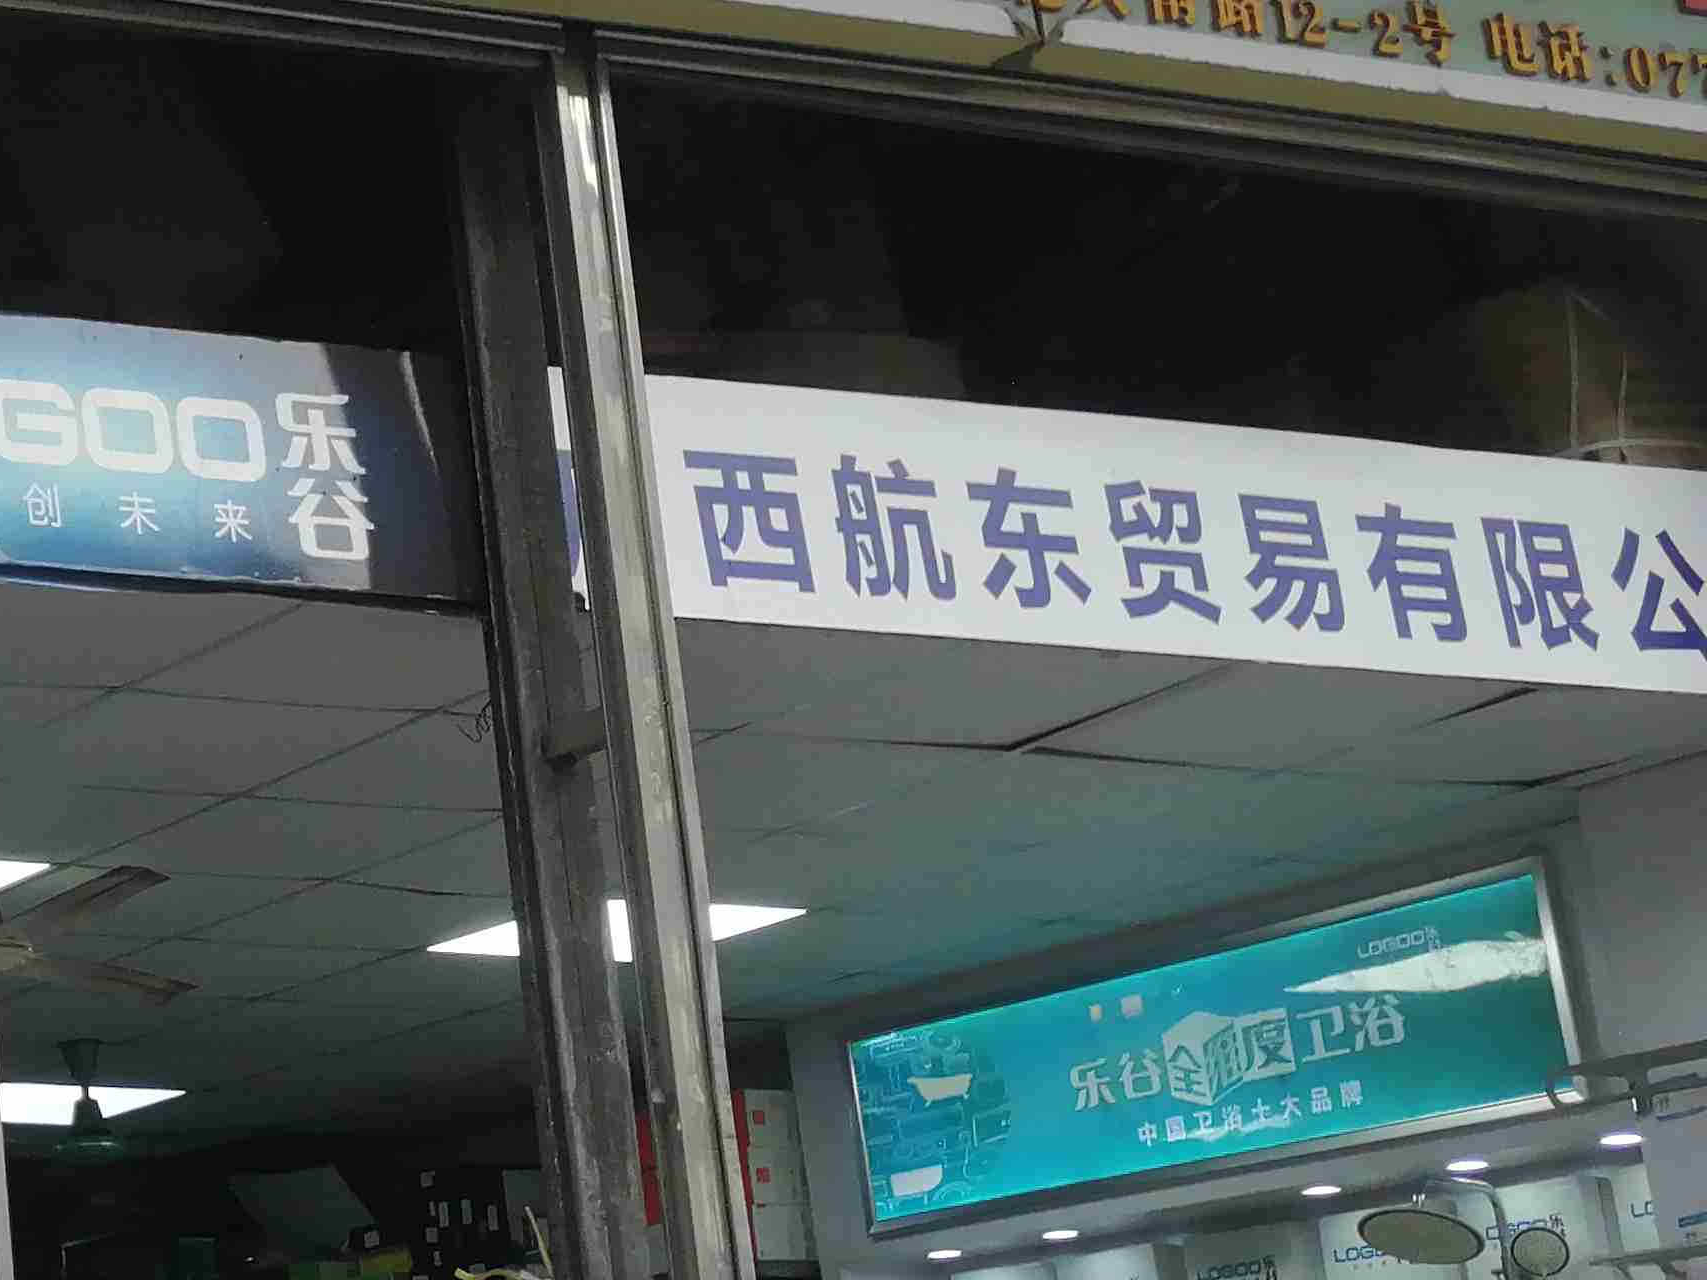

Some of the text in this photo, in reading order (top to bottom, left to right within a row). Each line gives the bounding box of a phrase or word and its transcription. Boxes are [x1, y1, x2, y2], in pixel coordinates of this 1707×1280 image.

[275, 393, 375, 560] 乐谷
[682, 449, 1707, 654] 西航东贸易有限公
